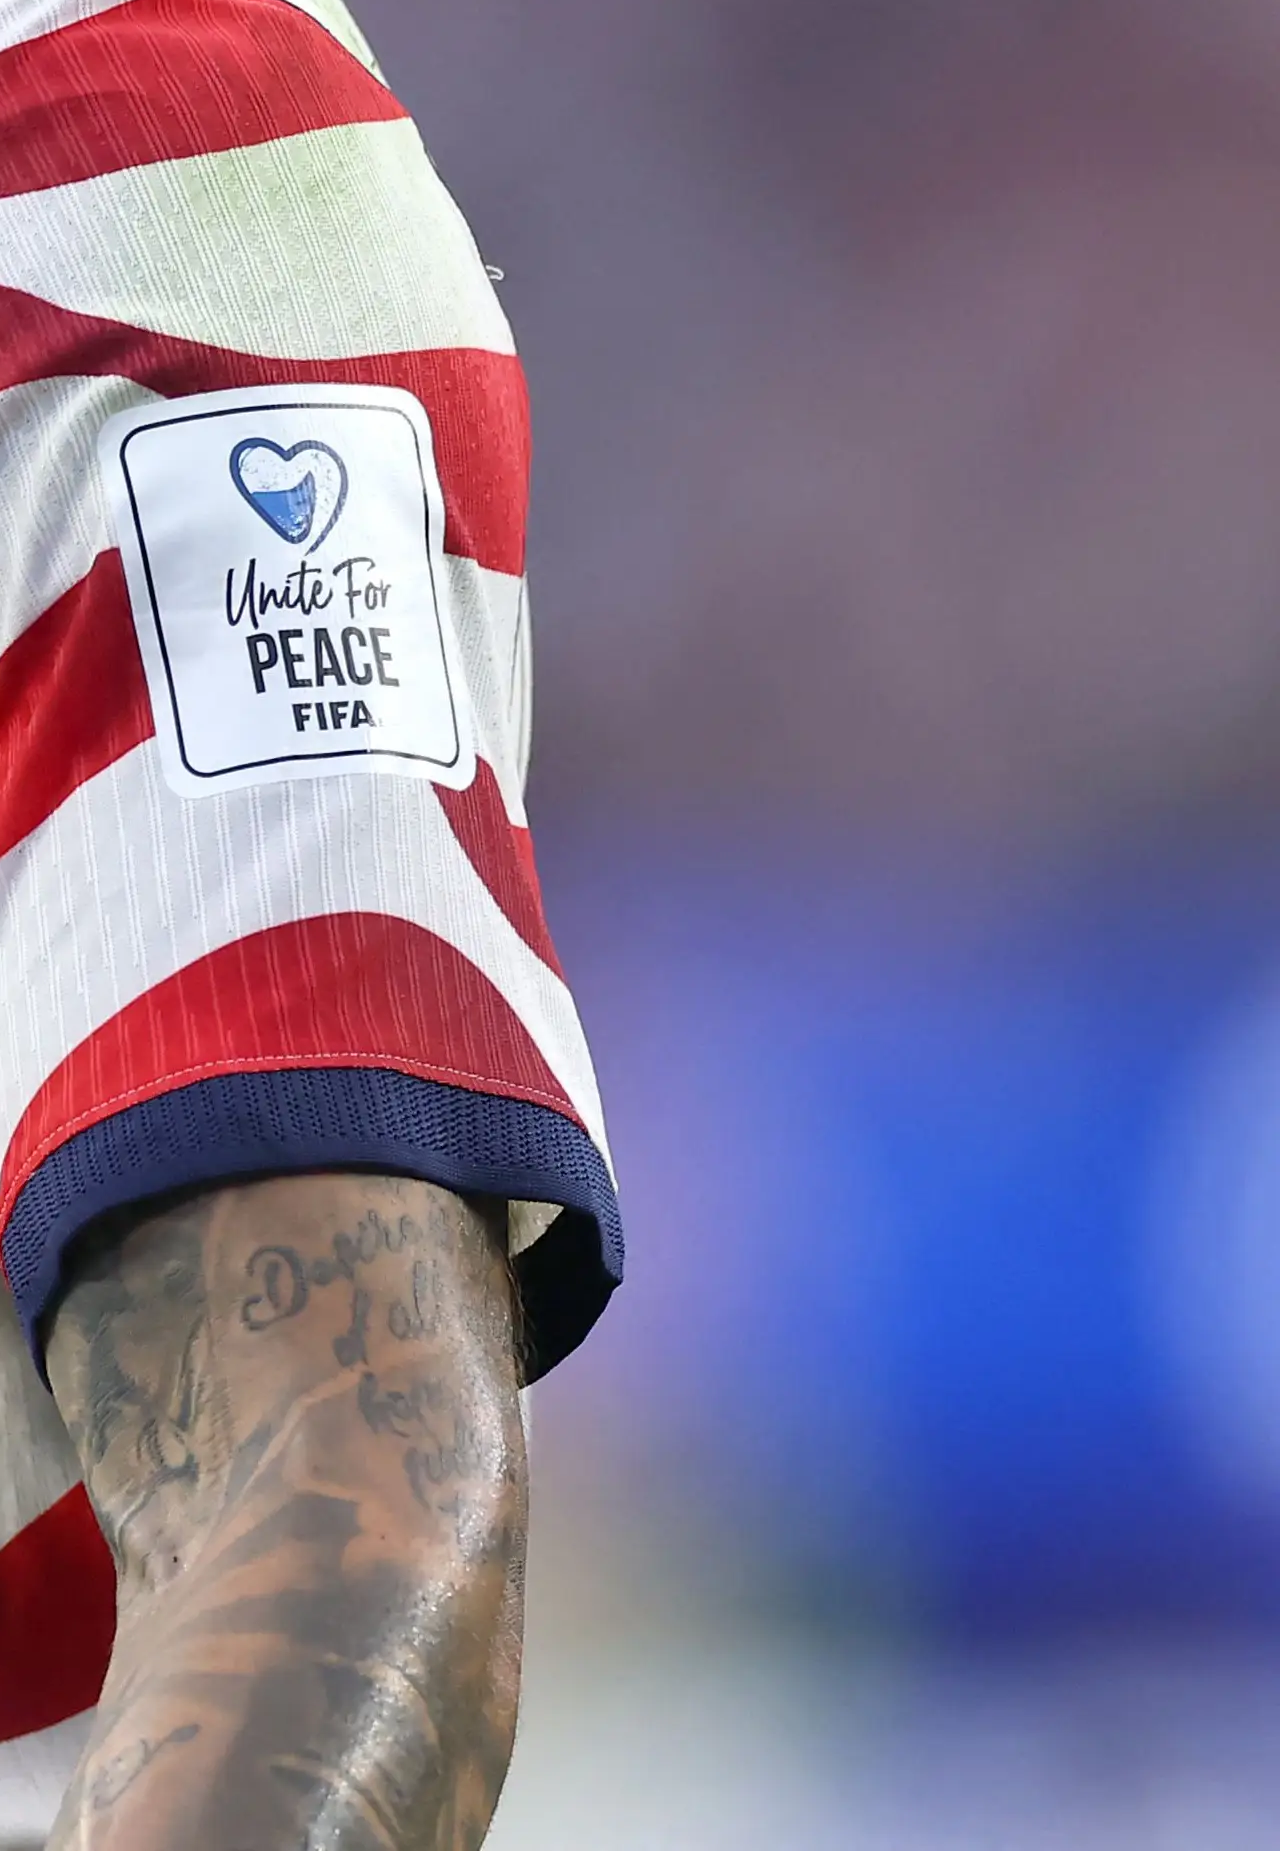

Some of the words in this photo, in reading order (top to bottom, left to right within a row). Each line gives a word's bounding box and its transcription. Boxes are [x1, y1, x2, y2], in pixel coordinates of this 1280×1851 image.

[226, 558, 333, 629] Unite
[333, 556, 391, 619] For
[246, 626, 399, 694] PEACE
[292, 700, 376, 732] FIFA
